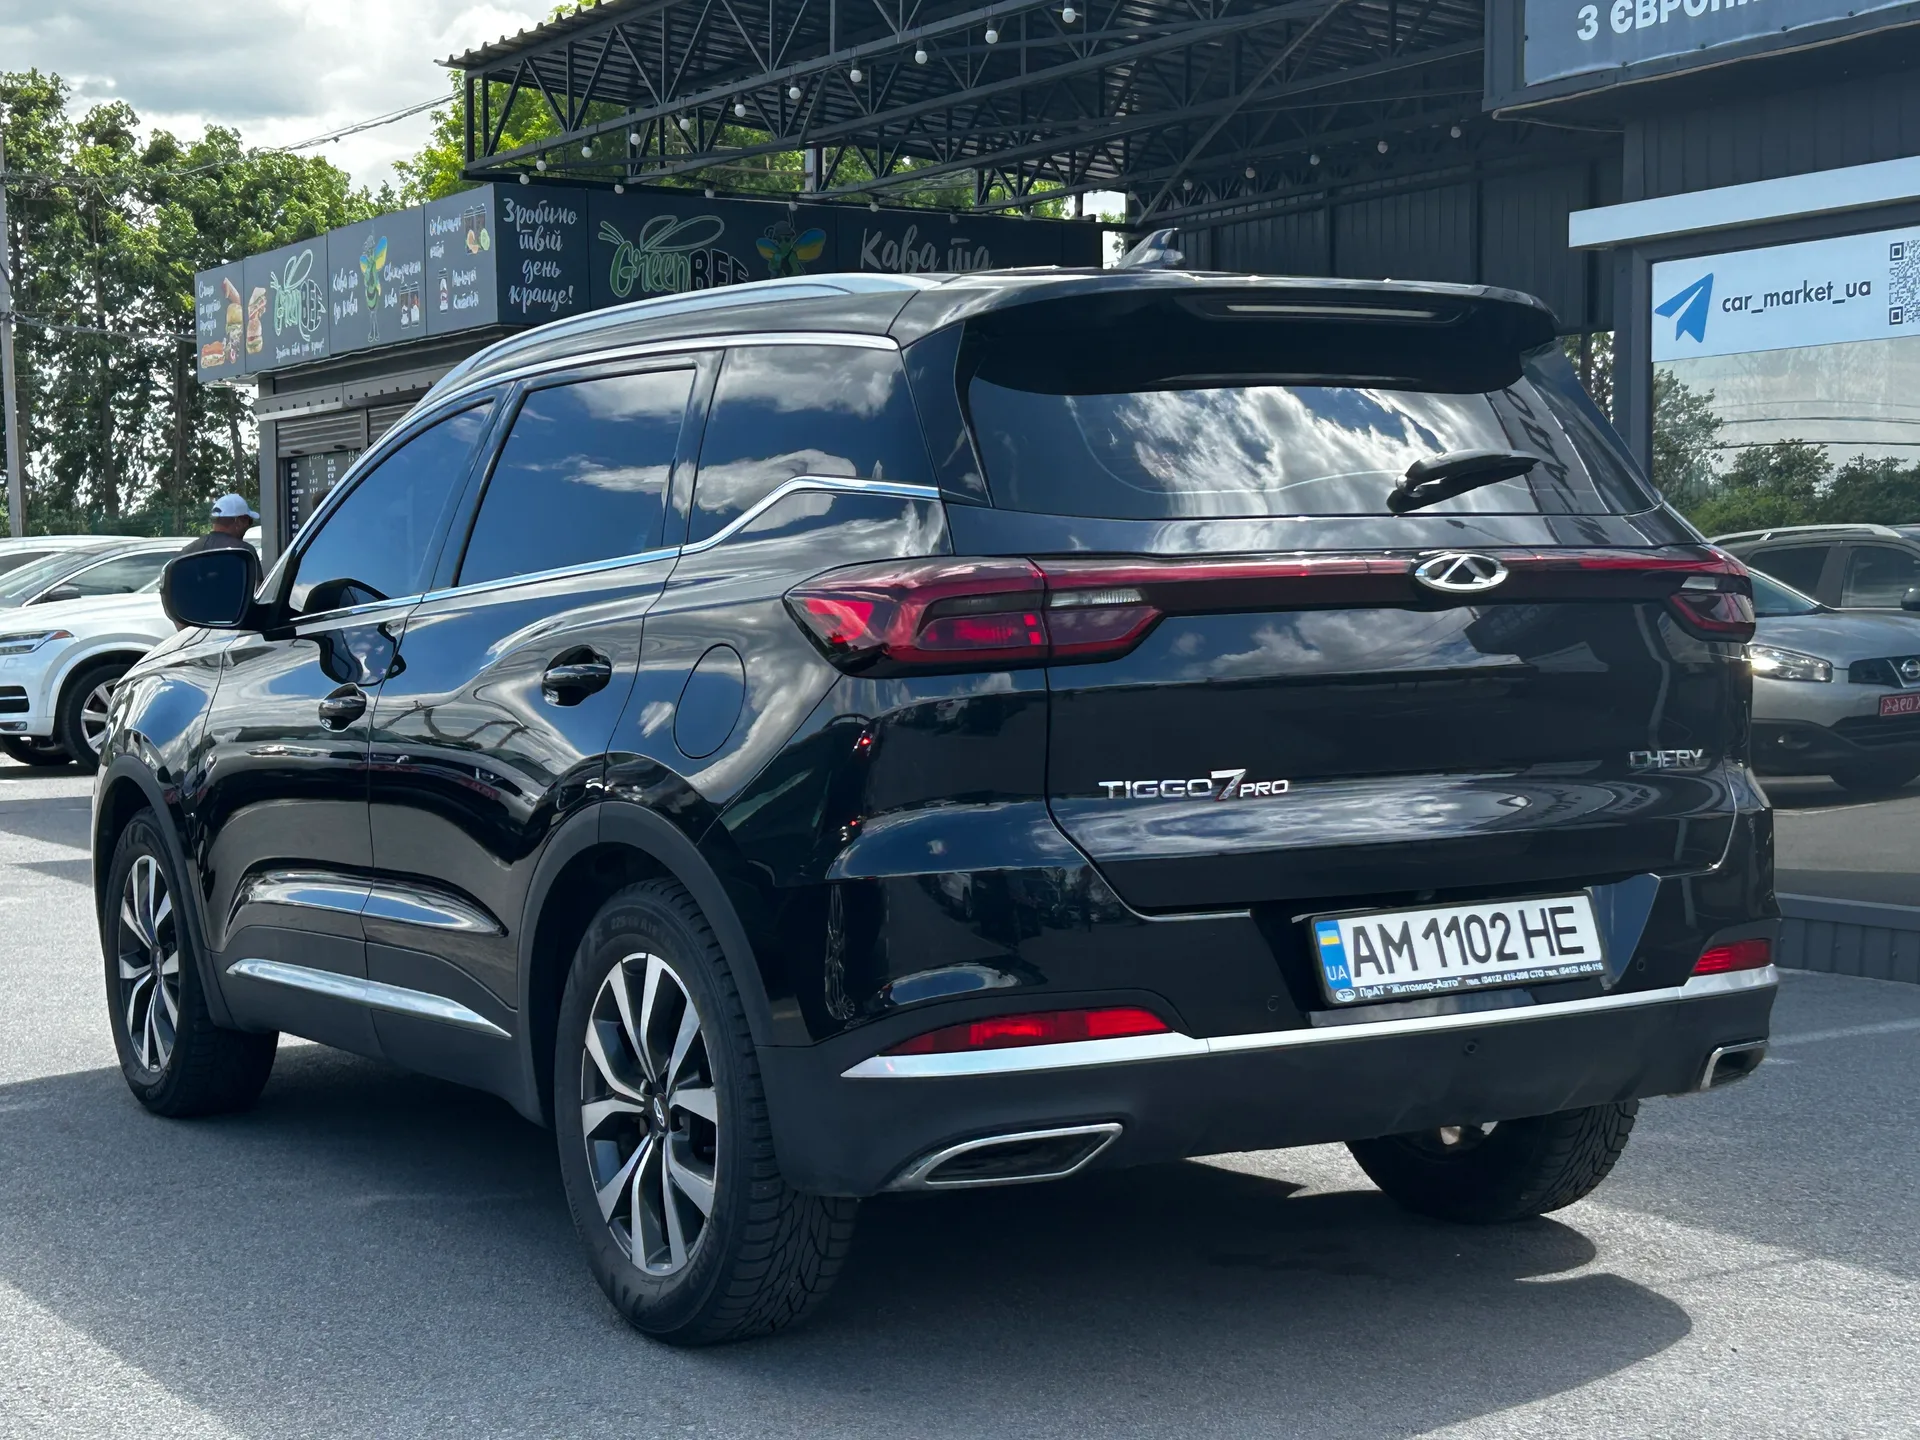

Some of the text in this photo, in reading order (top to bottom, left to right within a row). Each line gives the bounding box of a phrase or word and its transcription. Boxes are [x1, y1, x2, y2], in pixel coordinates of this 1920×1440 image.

[1577, 0, 1761, 41] З ЄВР
[503, 198, 577, 232] Зробимо
[519, 225, 563, 252] твій
[860, 224, 940, 273] Кава
[522, 259, 562, 284] день
[508, 285, 574, 314] краще!
[1722, 279, 1871, 314] car_market_ua
[1629, 749, 1704, 769] CHERY
[1352, 905, 1585, 978] AM 1102 HE
[1325, 964, 1349, 981] UA
